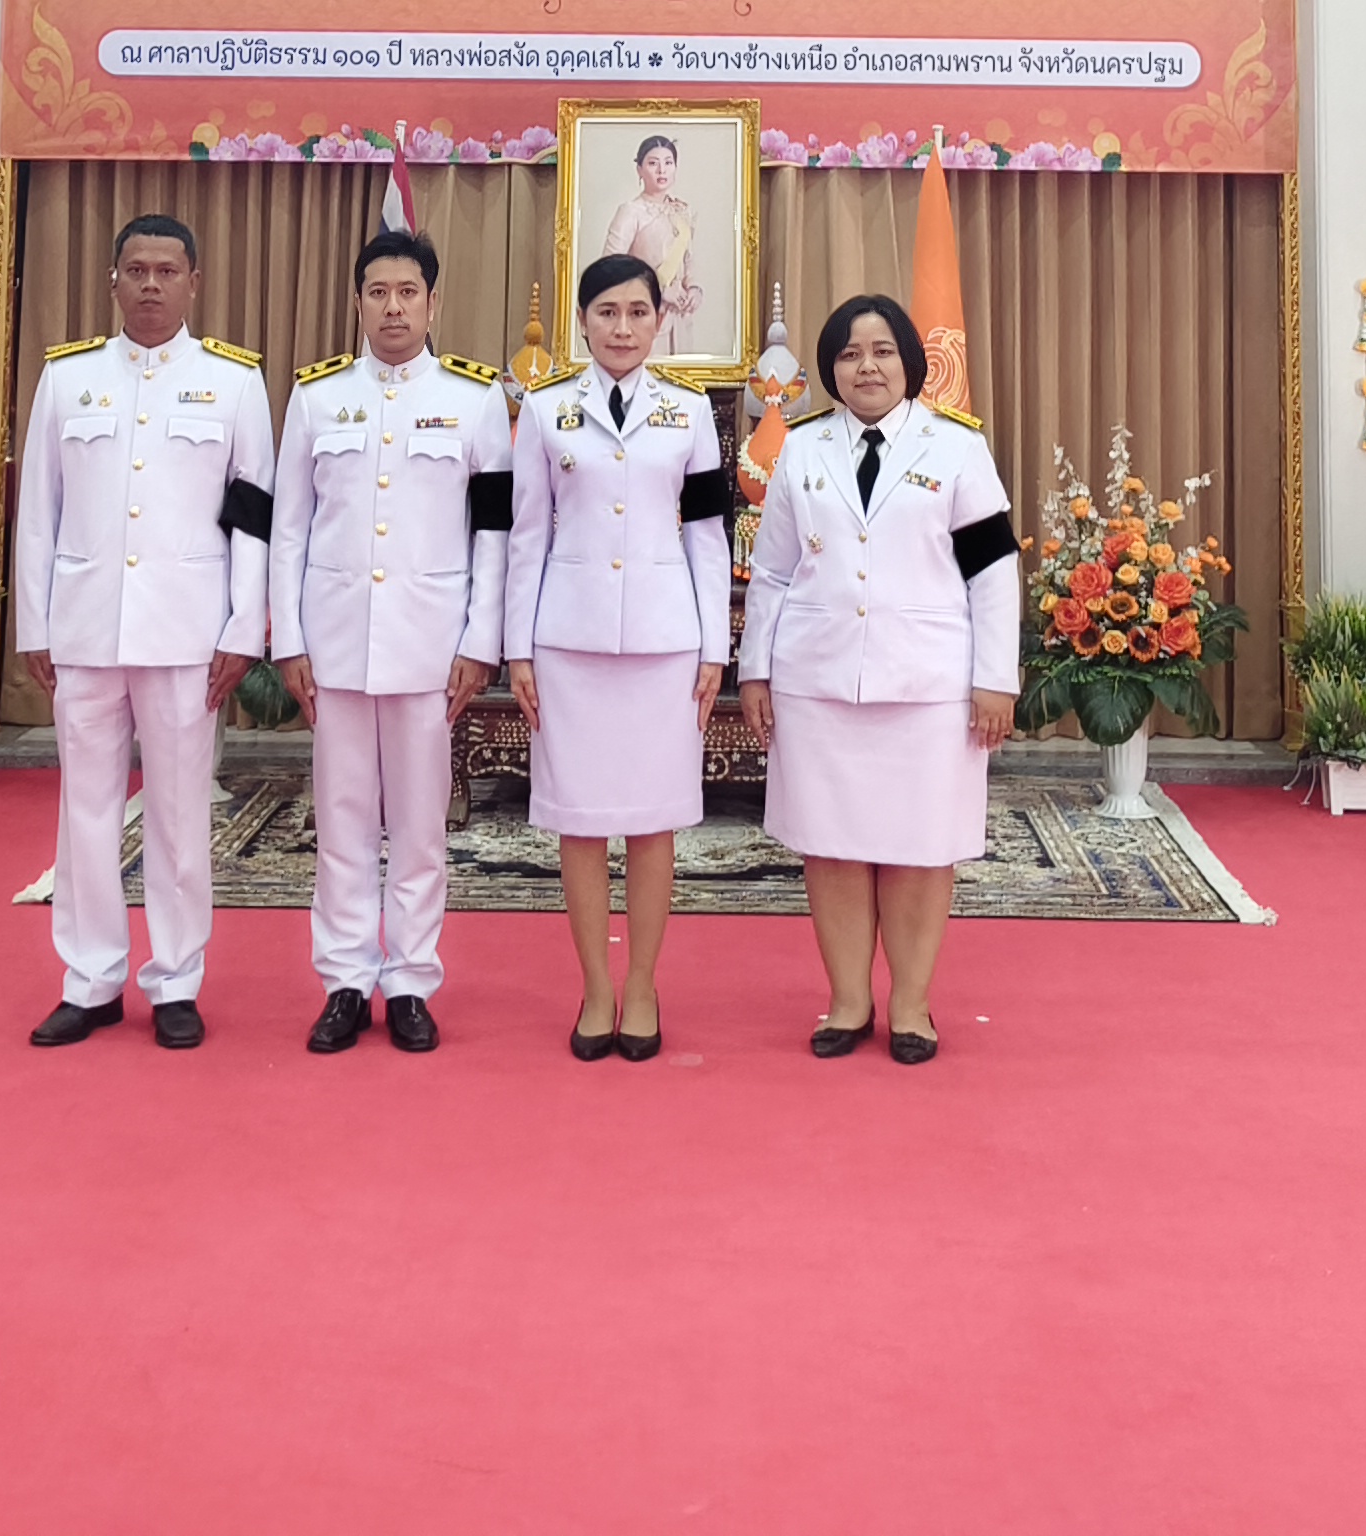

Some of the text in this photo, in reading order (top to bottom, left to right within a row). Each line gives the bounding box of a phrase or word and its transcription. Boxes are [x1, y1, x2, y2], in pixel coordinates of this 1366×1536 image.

[120, 45, 143, 65] ณ
[148, 38, 328, 72] ศาลาปฏิบัติธรรม
[332, 48, 382, 68] ๑๐๑
[386, 39, 403, 66] ปี
[409, 41, 540, 68] หลวงพ่อสงัด
[670, 42, 839, 72] วัดบางช้างเหนือ
[843, 46, 1014, 74] อำเภอสามพราน
[1018, 47, 1184, 83] จังหวัดนครปฐม
